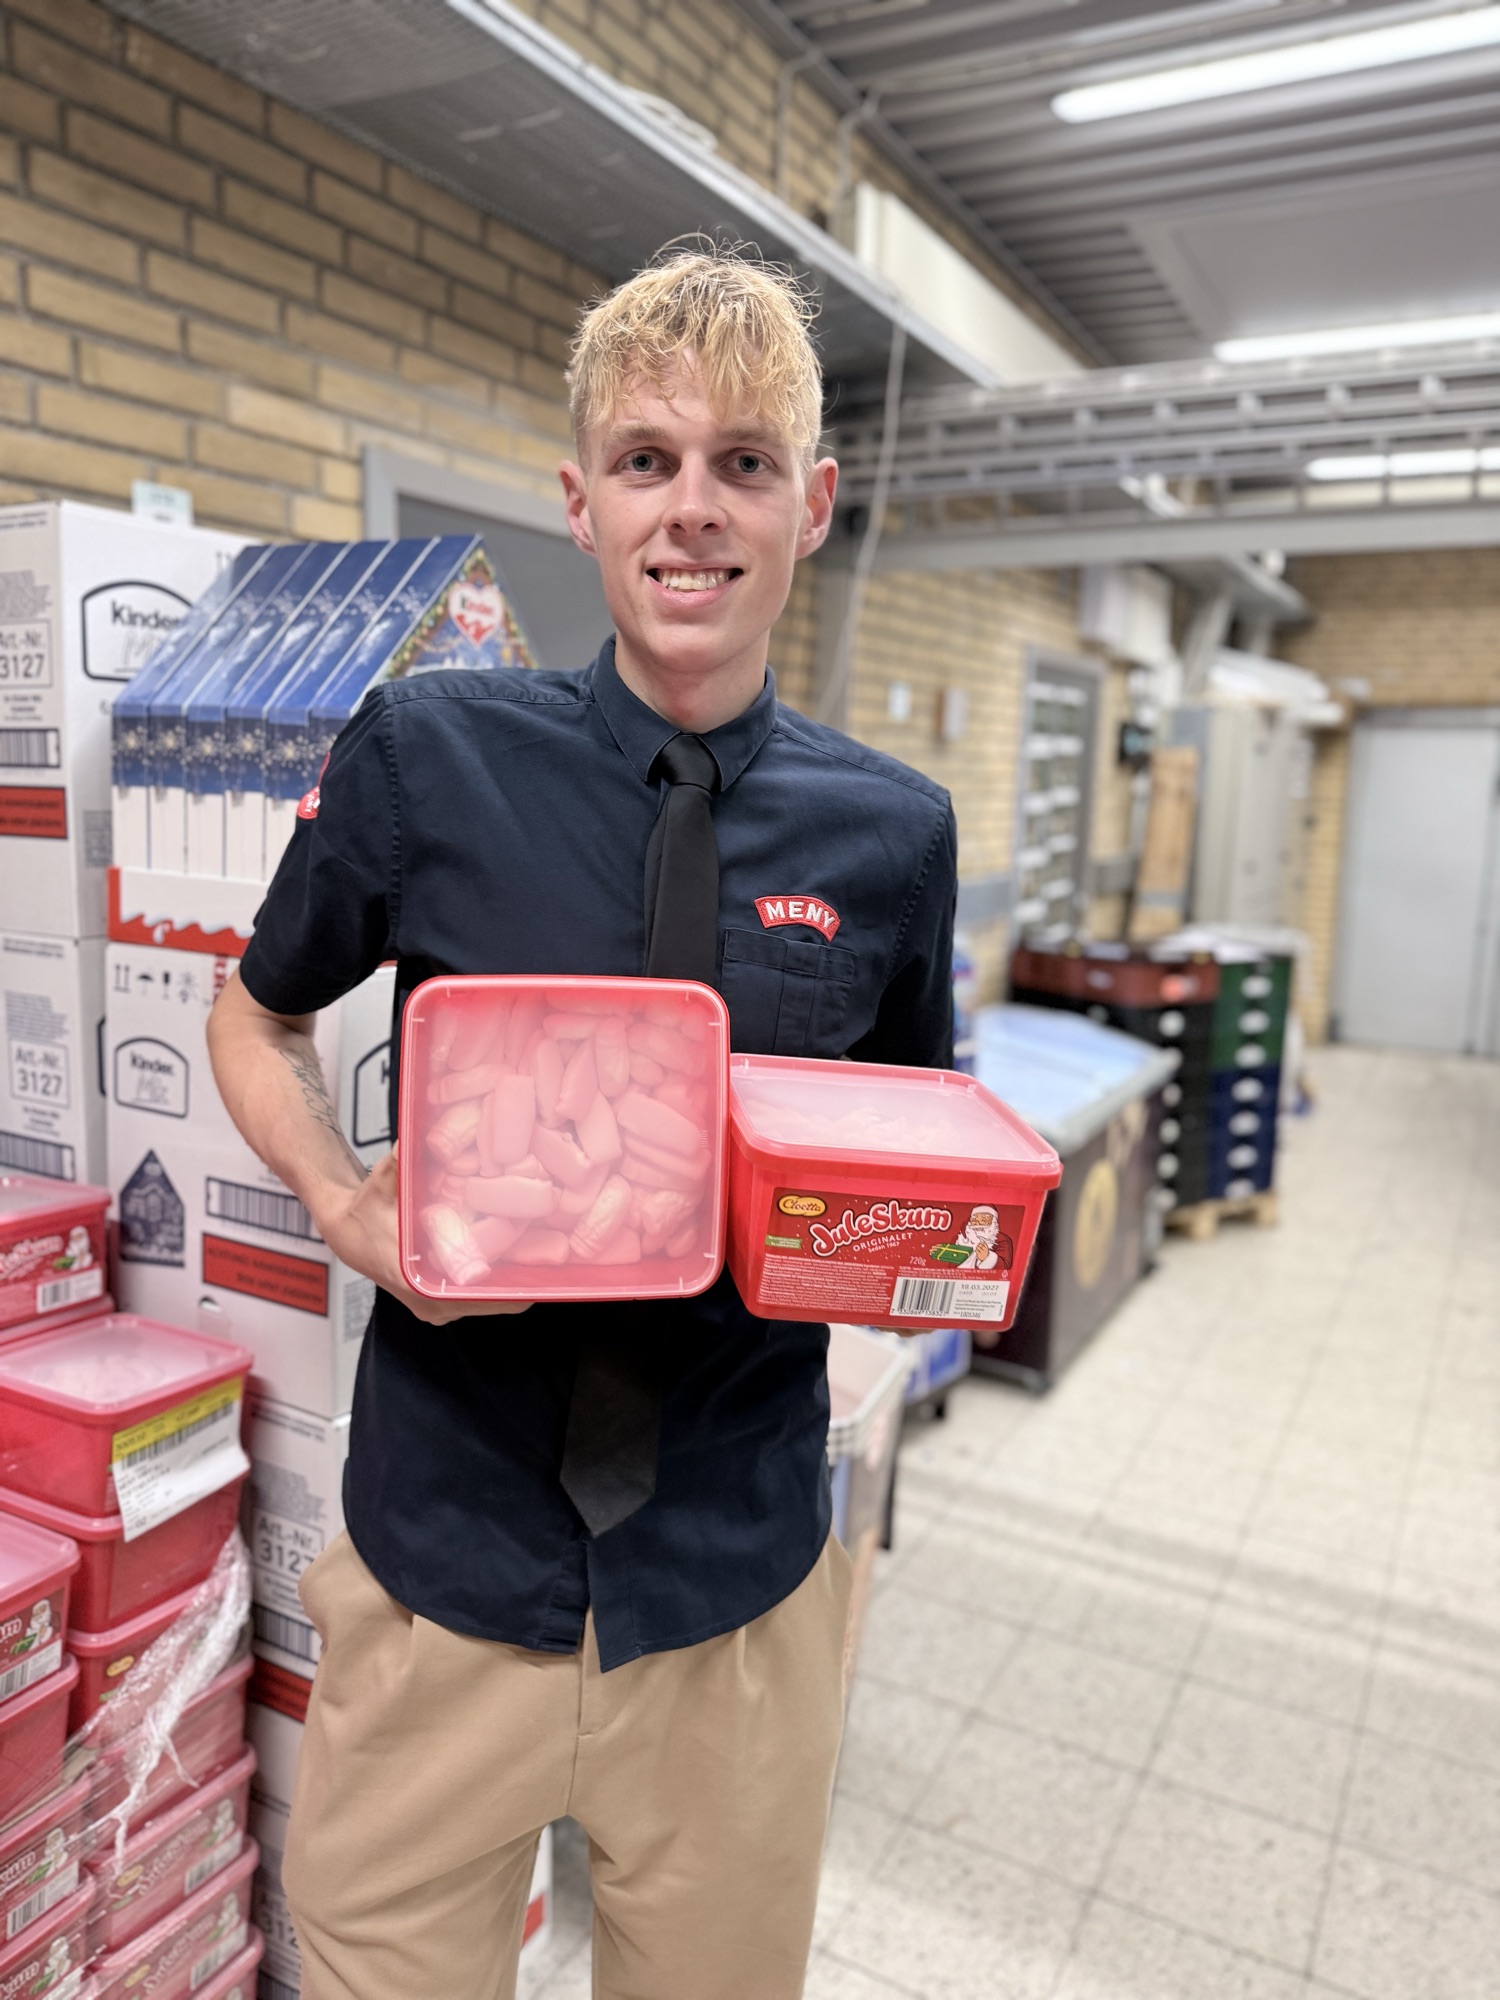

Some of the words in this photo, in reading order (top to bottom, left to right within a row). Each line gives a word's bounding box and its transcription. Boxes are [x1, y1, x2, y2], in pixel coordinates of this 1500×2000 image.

[0, 653, 44, 679] 3127
[764, 900, 835, 928] MENY
[18, 1070, 62, 1096] 3127
[782, 1198, 821, 1212] Cloetta
[808, 1200, 952, 1257] JuleSkum
[852, 1232, 913, 1252] ORIGINALET
[909, 1256, 927, 1267] 720g
